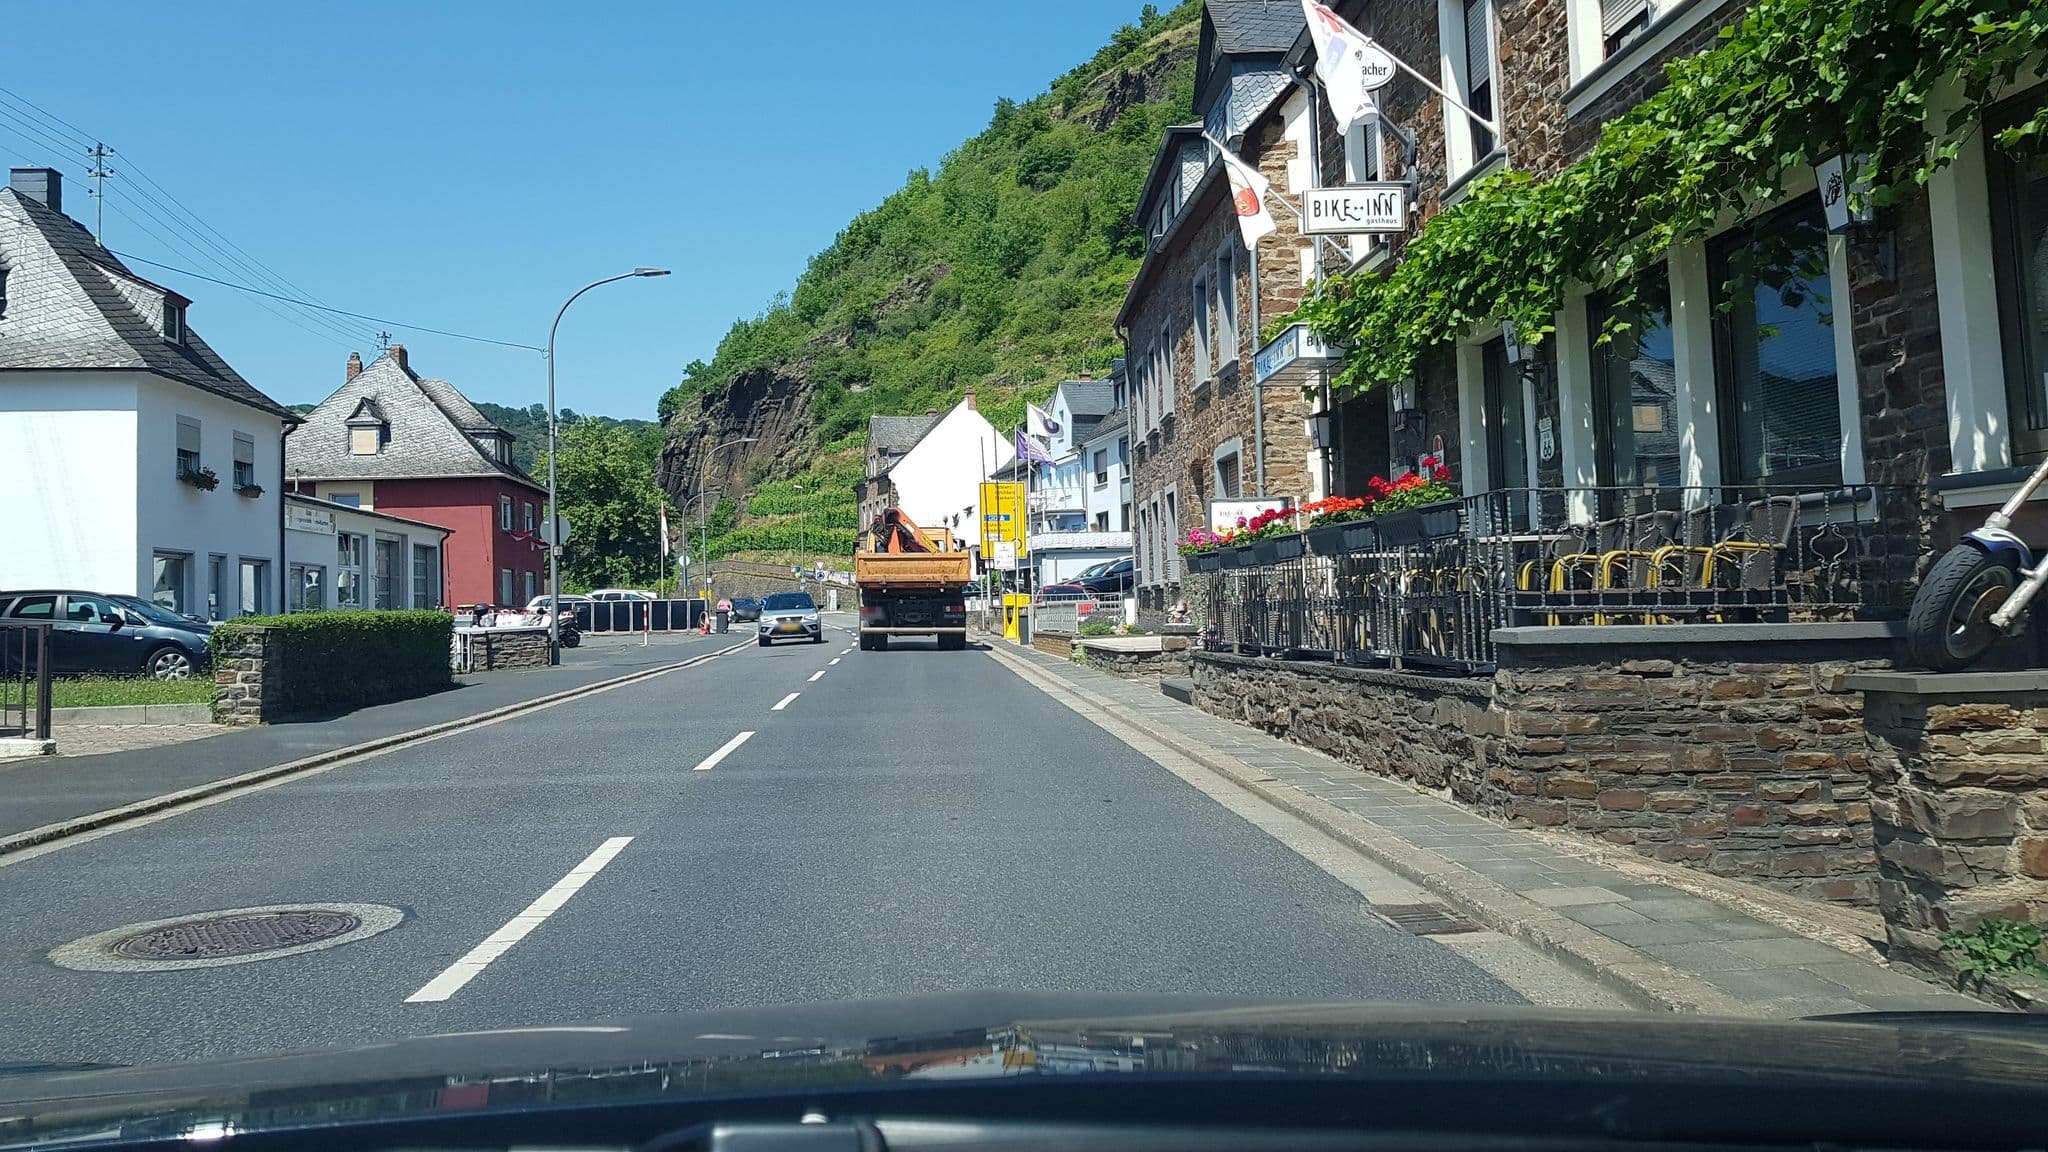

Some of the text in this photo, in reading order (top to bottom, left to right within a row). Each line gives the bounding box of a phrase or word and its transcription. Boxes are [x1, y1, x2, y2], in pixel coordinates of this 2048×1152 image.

[1362, 62, 1387, 76] acher
[1313, 193, 1397, 221] BIKE INN
[1366, 217, 1397, 225] gasthaus
[1543, 440, 1552, 457] 66
